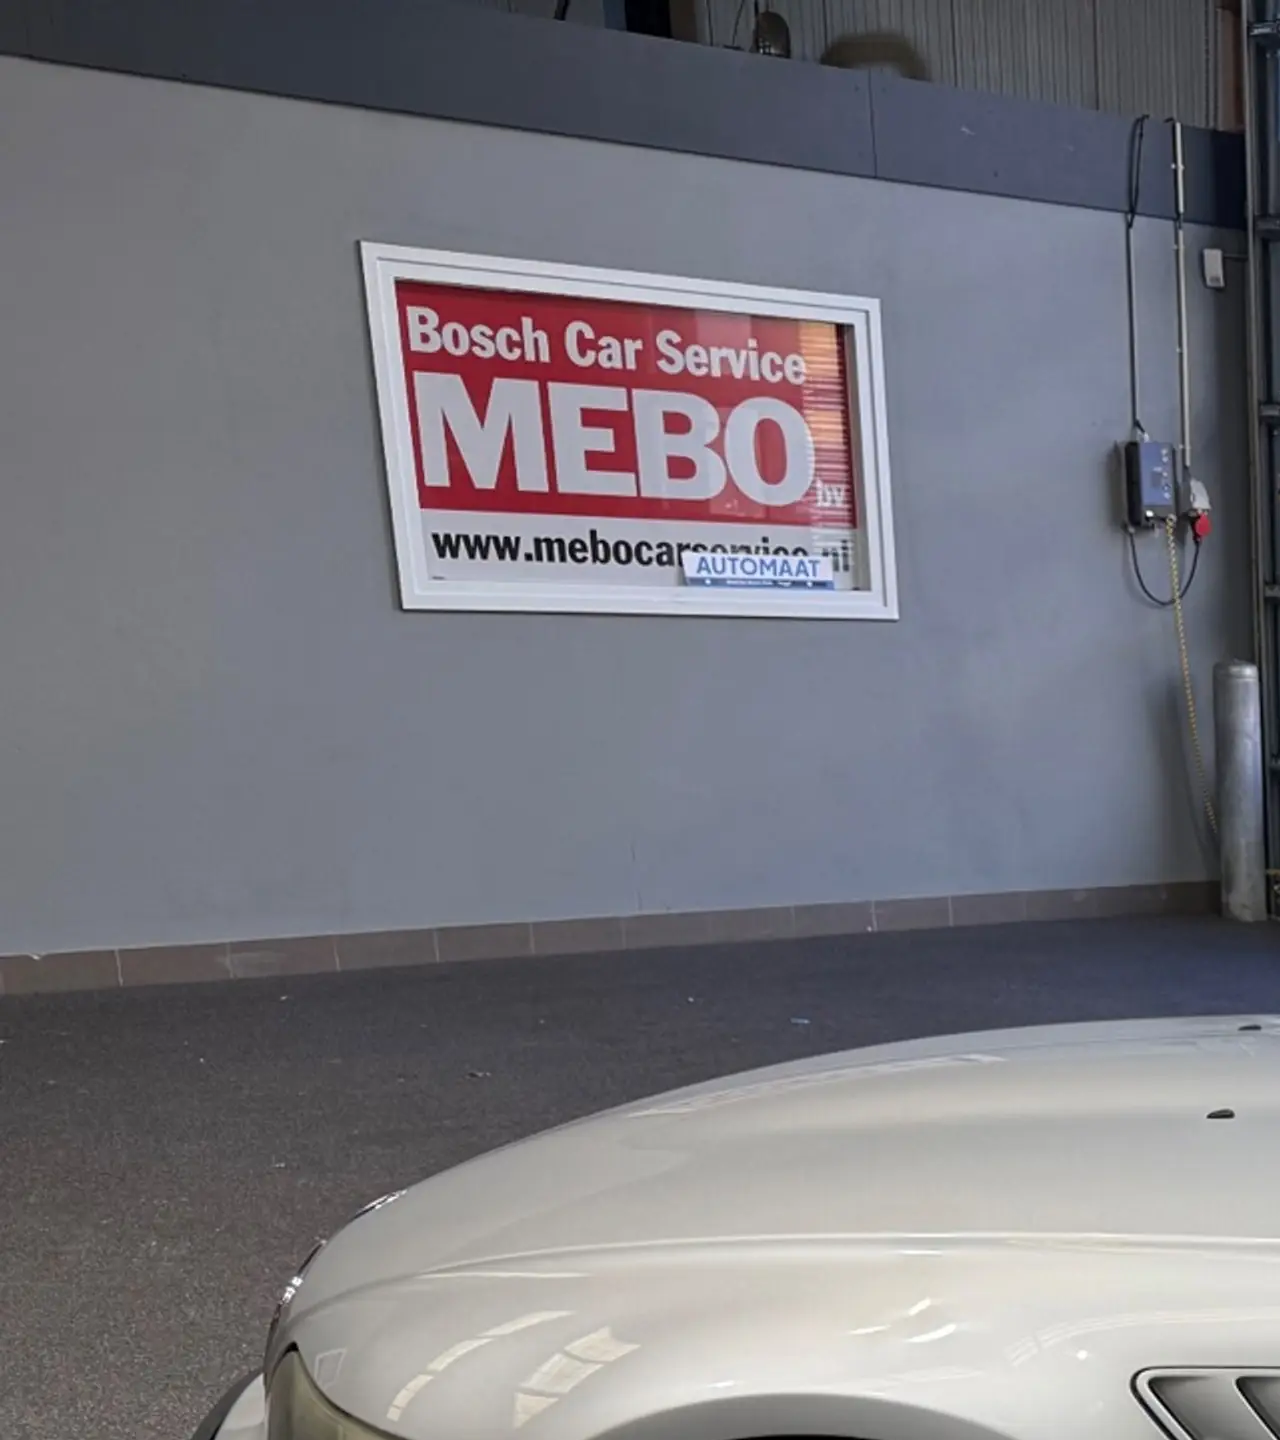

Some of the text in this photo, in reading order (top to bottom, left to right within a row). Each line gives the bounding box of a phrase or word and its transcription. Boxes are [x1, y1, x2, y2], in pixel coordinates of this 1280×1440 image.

[406, 305, 807, 385] Bosch Car Service
[412, 371, 816, 507] MEBO
[696, 556, 821, 578] AUTOMAAT
